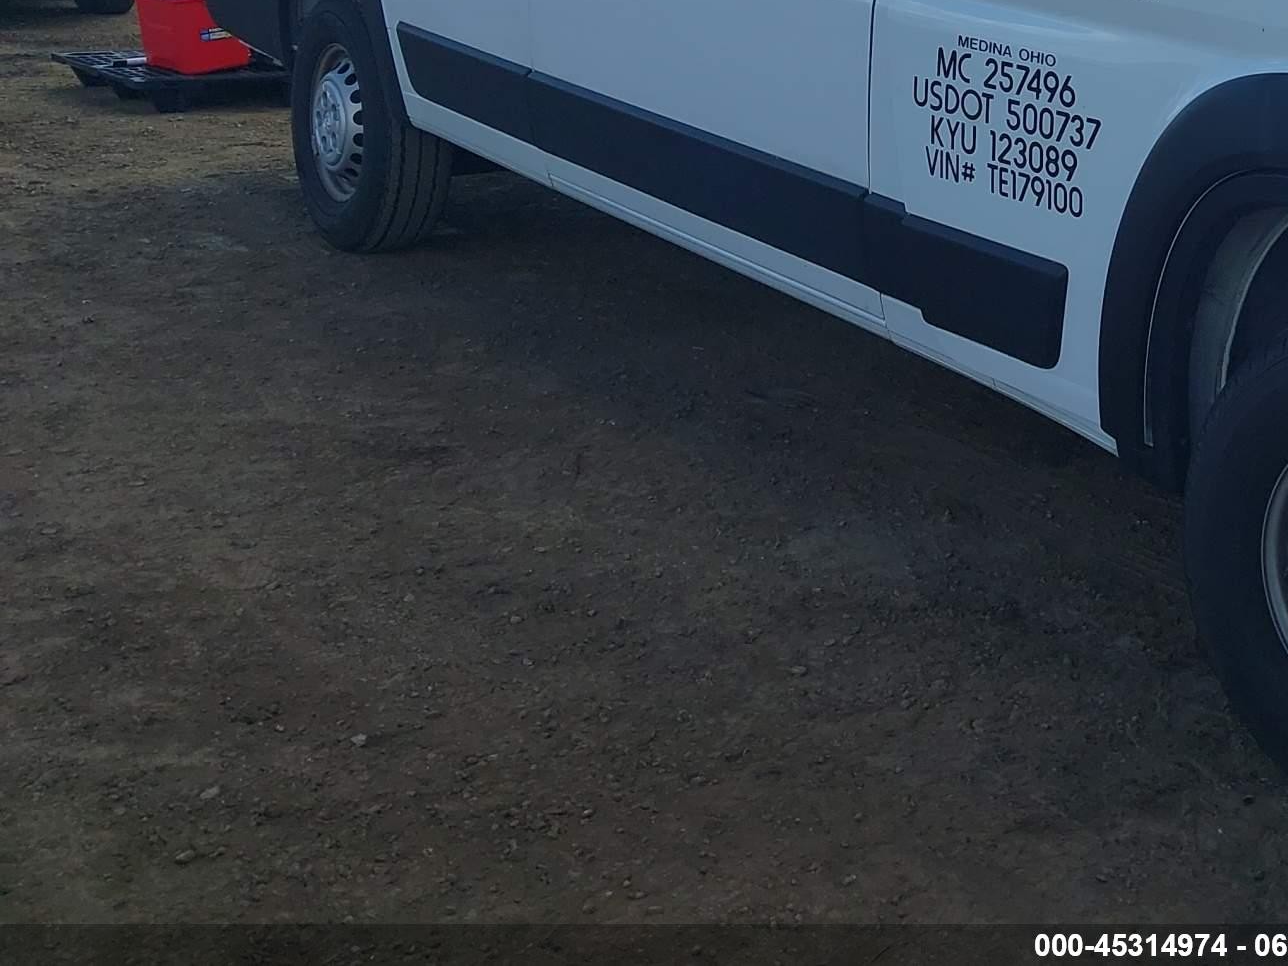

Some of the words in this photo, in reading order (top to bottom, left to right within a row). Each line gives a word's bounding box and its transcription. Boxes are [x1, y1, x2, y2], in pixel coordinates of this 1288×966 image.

[937, 47, 972, 84] MC
[983, 57, 1076, 108] 257496
[958, 35, 1012, 57] MEDINA
[1018, 48, 1057, 67] OHIO
[913, 76, 994, 124] USDOT
[1006, 98, 1101, 150] 500737
[925, 145, 976, 183] VIN#
[987, 162, 1083, 218] TE179100
[930, 115, 977, 155] KYU
[990, 130, 1078, 182] 123089
